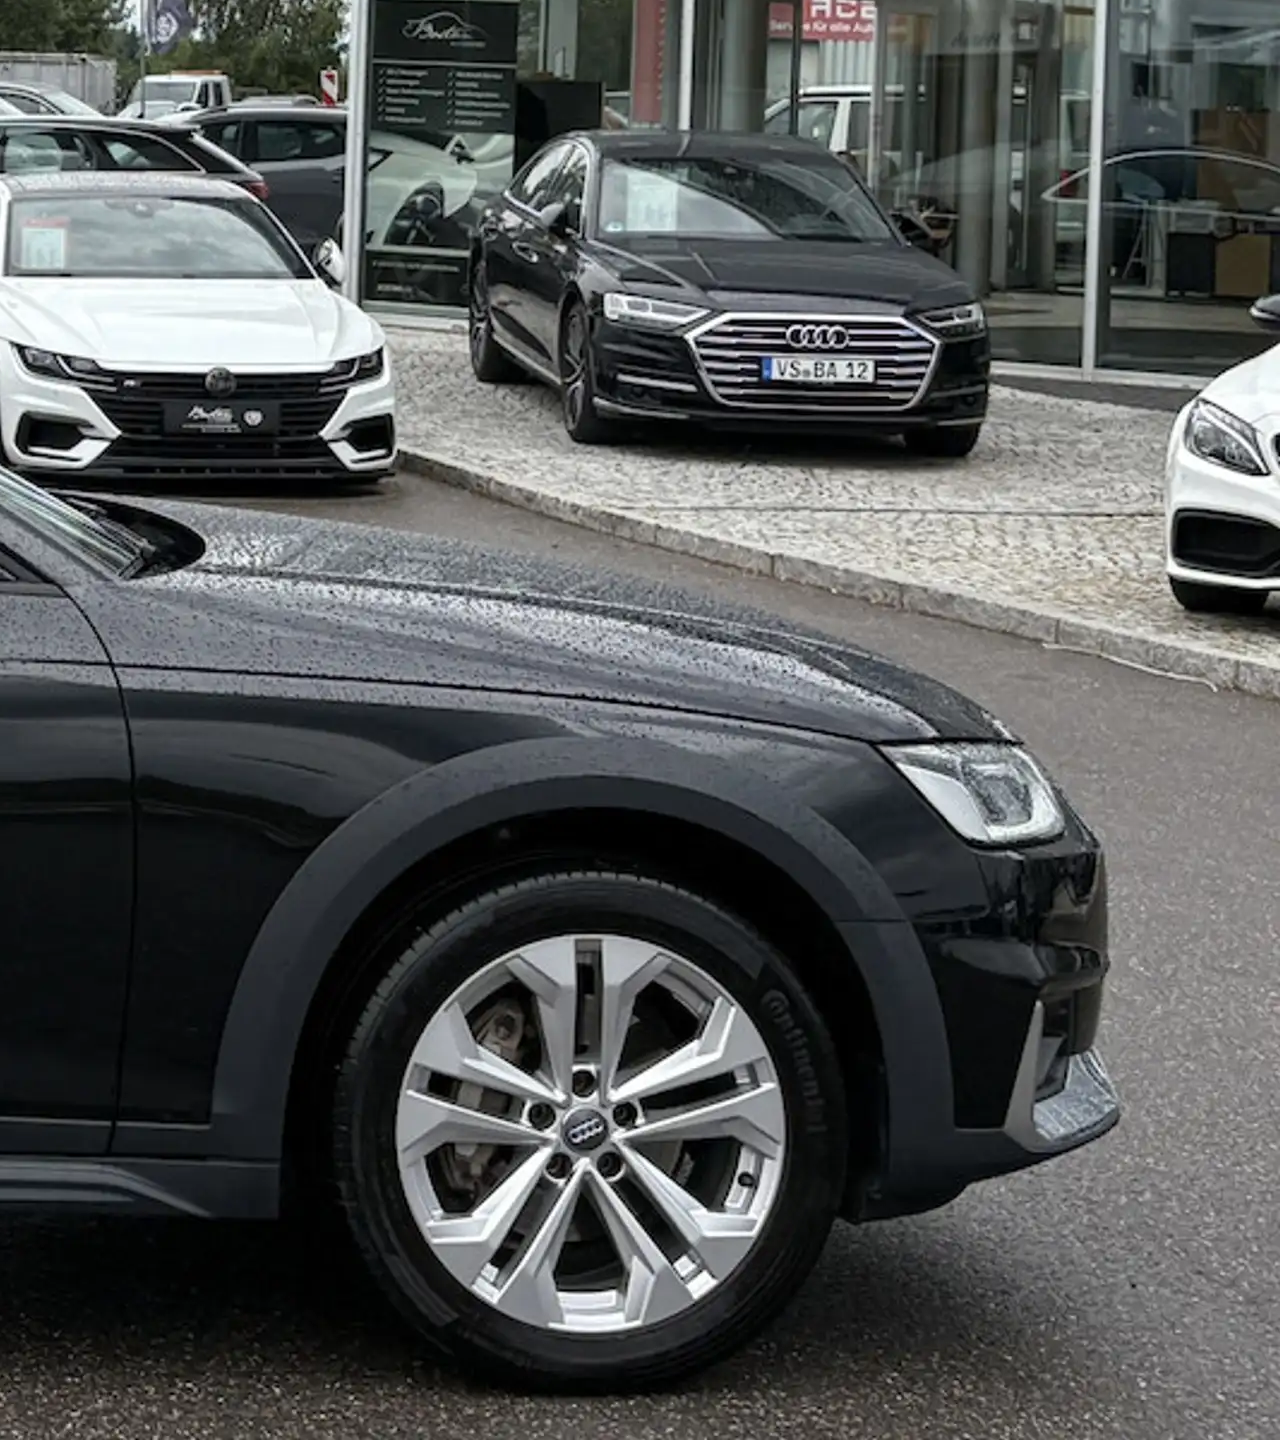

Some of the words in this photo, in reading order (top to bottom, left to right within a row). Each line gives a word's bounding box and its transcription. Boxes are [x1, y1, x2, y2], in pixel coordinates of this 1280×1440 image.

[776, 359, 801, 378] VS
[814, 361, 837, 379] BA
[845, 362, 869, 380] 12
